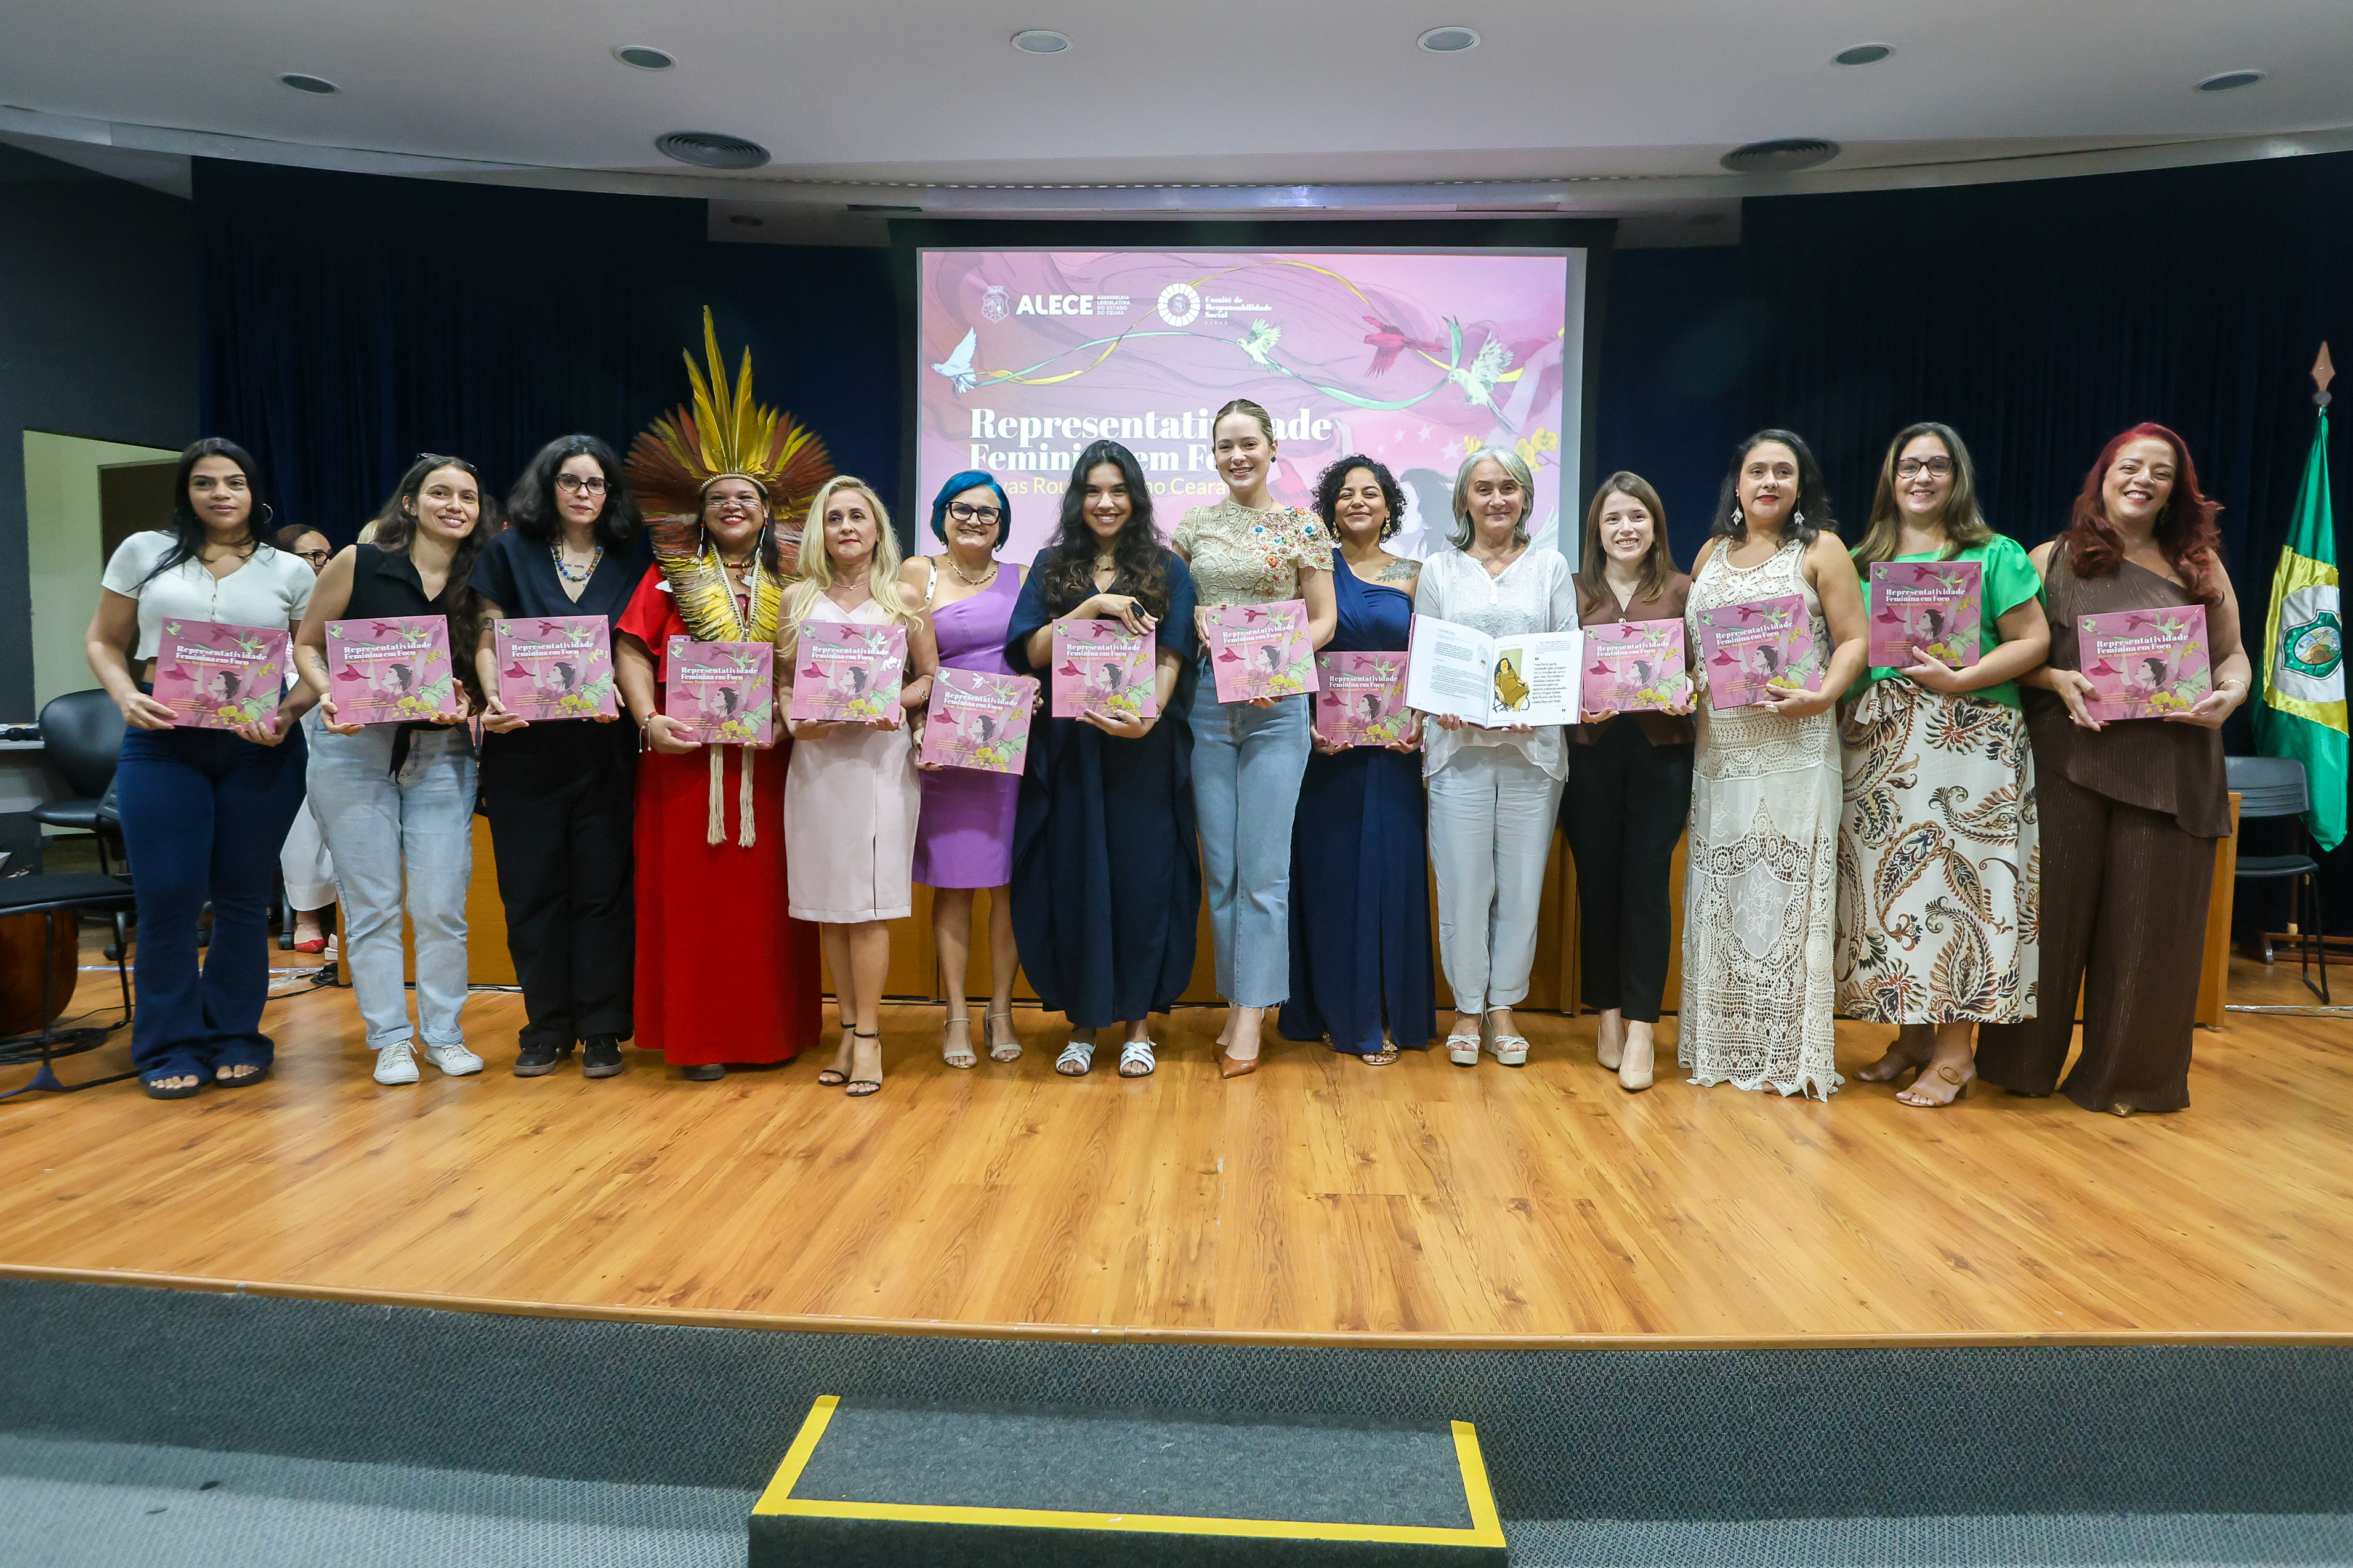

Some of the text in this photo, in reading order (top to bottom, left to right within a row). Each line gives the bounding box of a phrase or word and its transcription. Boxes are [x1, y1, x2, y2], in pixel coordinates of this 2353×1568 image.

[1015, 294, 1094, 315] ALECE
[1205, 296, 1232, 304] Comité
[1205, 303, 1273, 314] Responsabilidade
[969, 408, 1332, 448] Representatiade
[969, 443, 1081, 471] Femini
[1133, 451, 1181, 472] em
[1886, 588, 1965, 597] Representatividade
[1222, 624, 1294, 638] Representatividade
[1716, 621, 1793, 639] Representatividade
[1223, 635, 1255, 643] Feminina
[1717, 636, 1750, 645] Feminina
[2097, 633, 2189, 648] Representatividade
[344, 641, 432, 654] Representatividade
[512, 641, 594, 651] Representatividade
[813, 646, 890, 655] Representatividade
[1597, 641, 1670, 652] Representatividade
[2097, 646, 2136, 654] Feminina
[176, 653, 215, 662] Feminina
[177, 645, 267, 660] Representatividade
[943, 698, 975, 707] Feminina
[945, 691, 1018, 706] Representatividade
